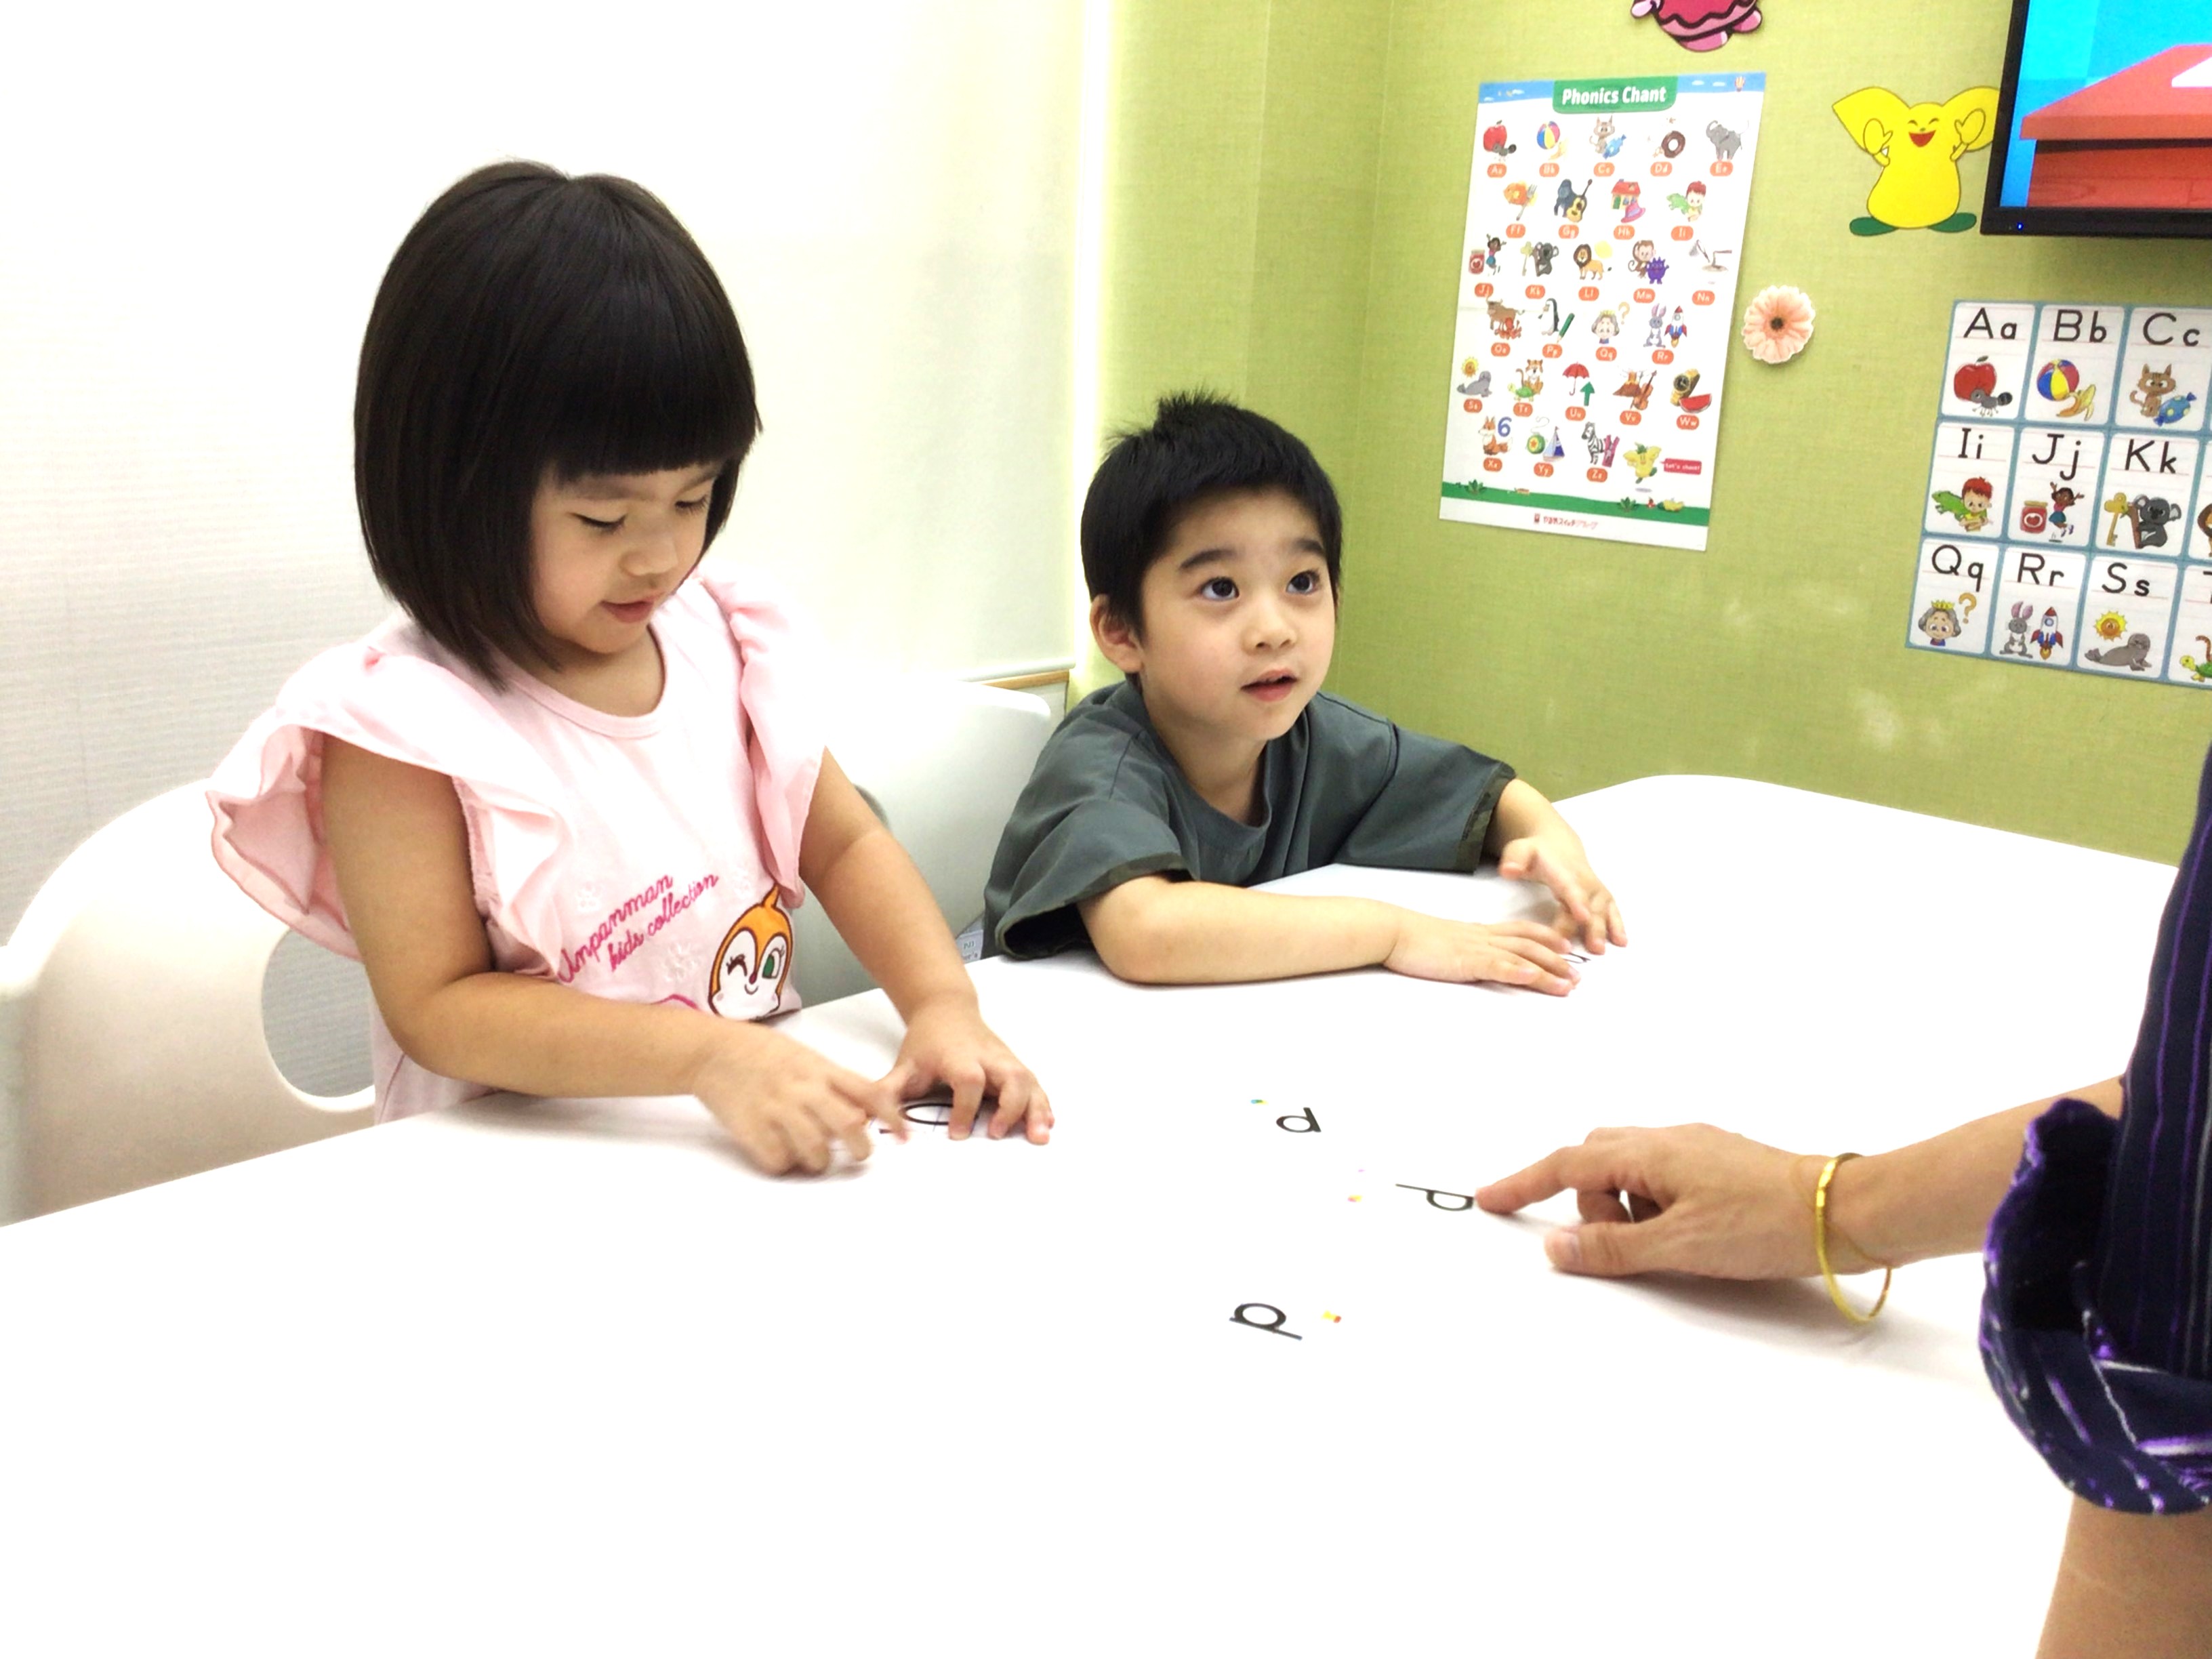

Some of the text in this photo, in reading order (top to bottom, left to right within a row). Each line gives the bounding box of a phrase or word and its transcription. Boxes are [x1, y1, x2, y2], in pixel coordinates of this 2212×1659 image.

[1562, 86, 1666, 105] Phonics Chant
[1637, 291, 1652, 300] Mm
[1698, 292, 1710, 302] Nn
[1964, 308, 2017, 340] Aa
[2053, 309, 2107, 343] Bb
[2143, 312, 2200, 347] Cc
[1657, 351, 1669, 361] Rr
[1624, 413, 1636, 422] Vv
[1680, 416, 1697, 427] Ww
[1959, 428, 1984, 459] Ii
[2032, 434, 2081, 480] Jj
[2125, 439, 2177, 474] Kk
[1538, 464, 1549, 476] Yy
[1931, 544, 1984, 592] Qq
[2018, 553, 2064, 586] Rr
[2102, 562, 2150, 596] Ss
[607, 872, 719, 972] kids collection
